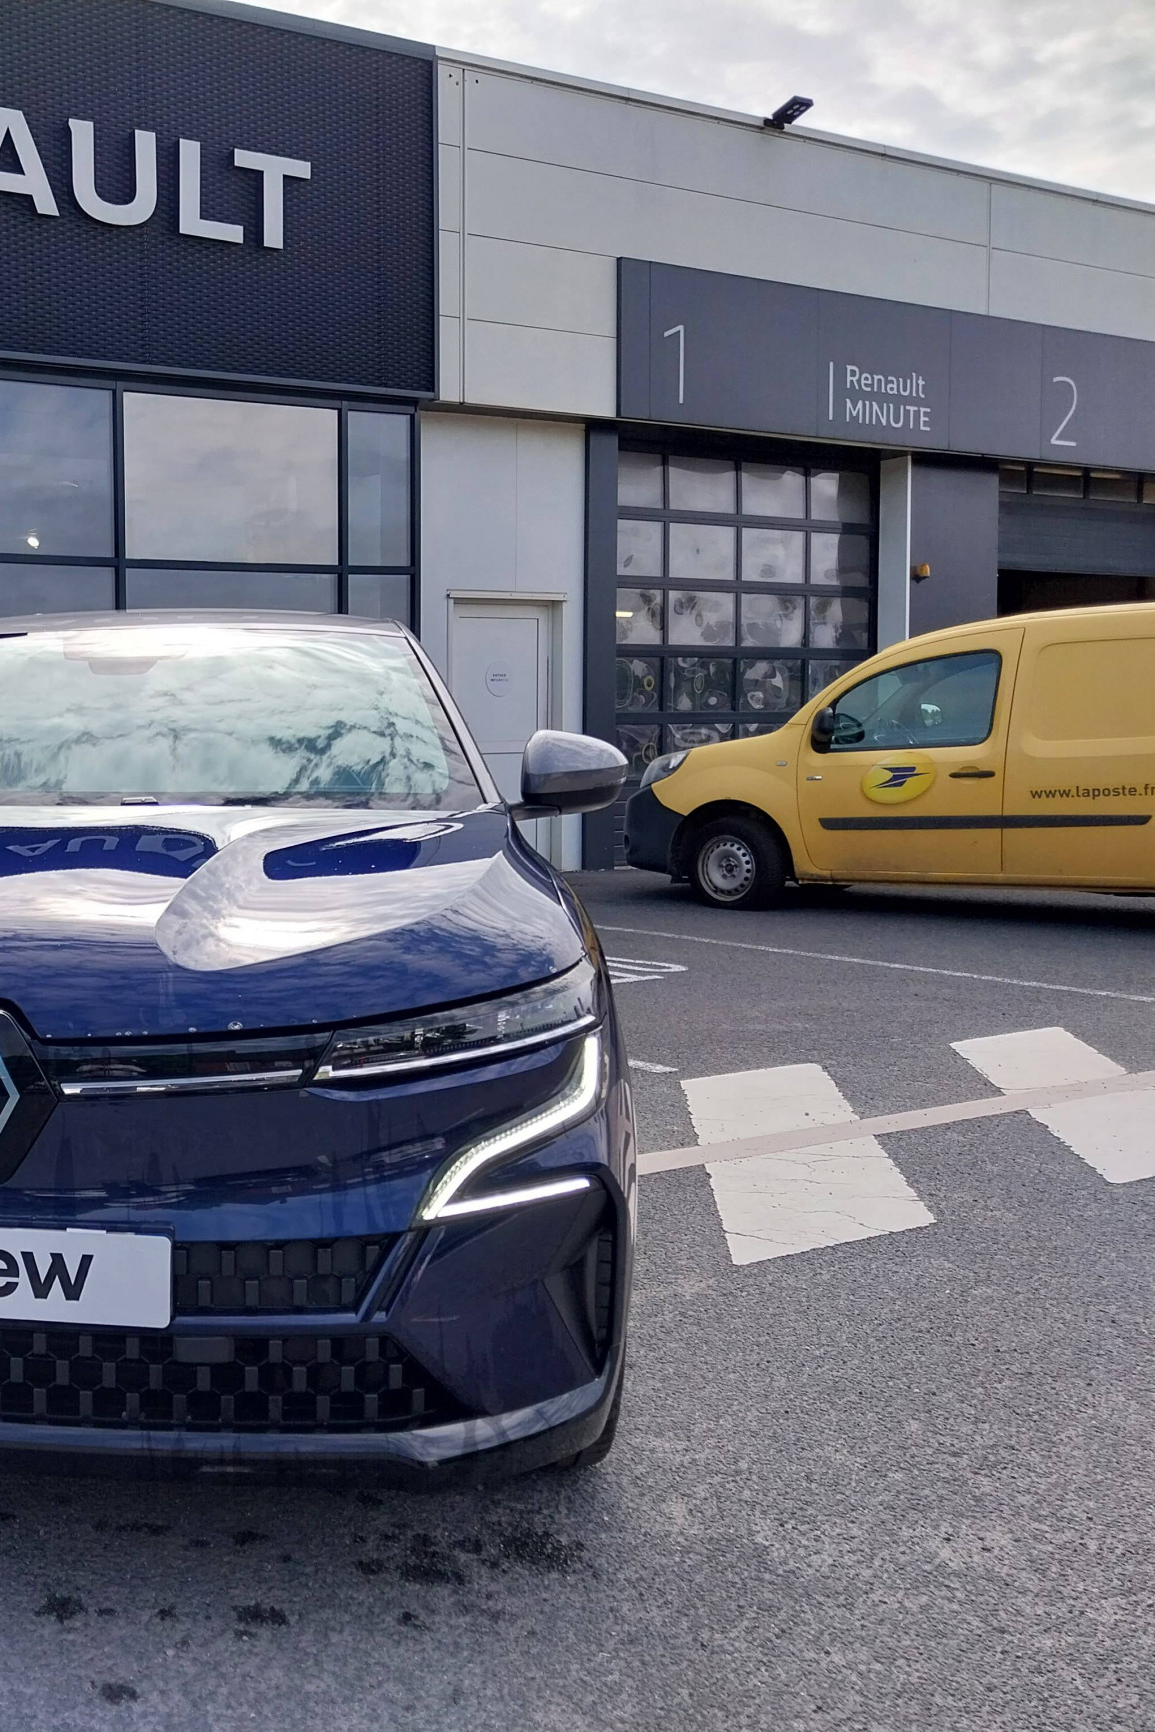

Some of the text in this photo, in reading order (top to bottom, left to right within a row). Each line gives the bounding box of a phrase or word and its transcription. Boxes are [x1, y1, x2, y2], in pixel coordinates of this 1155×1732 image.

[663, 324, 685, 404] 1
[846, 365, 925, 398] Renault
[846, 399, 932, 431] MINUTE
[1050, 376, 1078, 447] 2
[1029, 783, 1155, 800] www.laposte.fr
